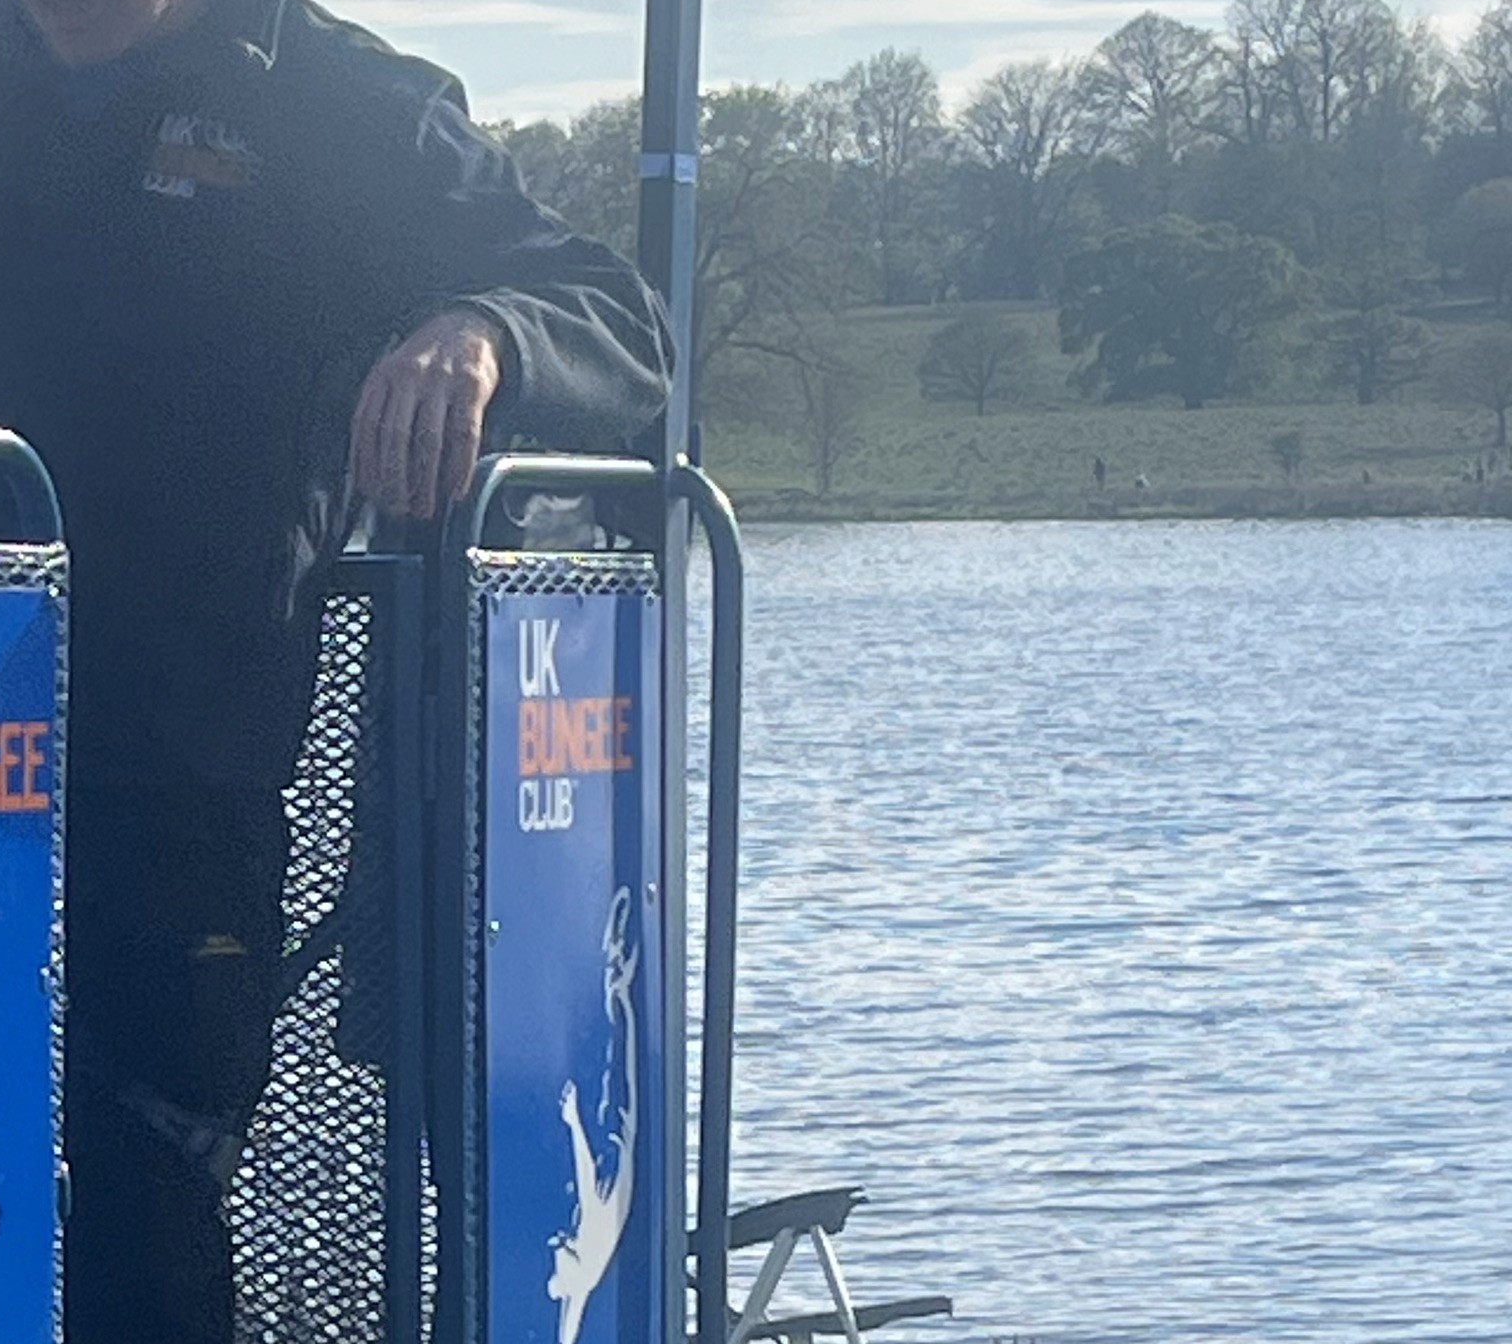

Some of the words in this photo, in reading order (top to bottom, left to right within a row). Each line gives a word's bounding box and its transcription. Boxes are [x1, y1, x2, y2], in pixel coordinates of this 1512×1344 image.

[519, 619, 560, 696] UK
[519, 697, 633, 777] BUNGEE
[519, 778, 573, 832] CLUB
